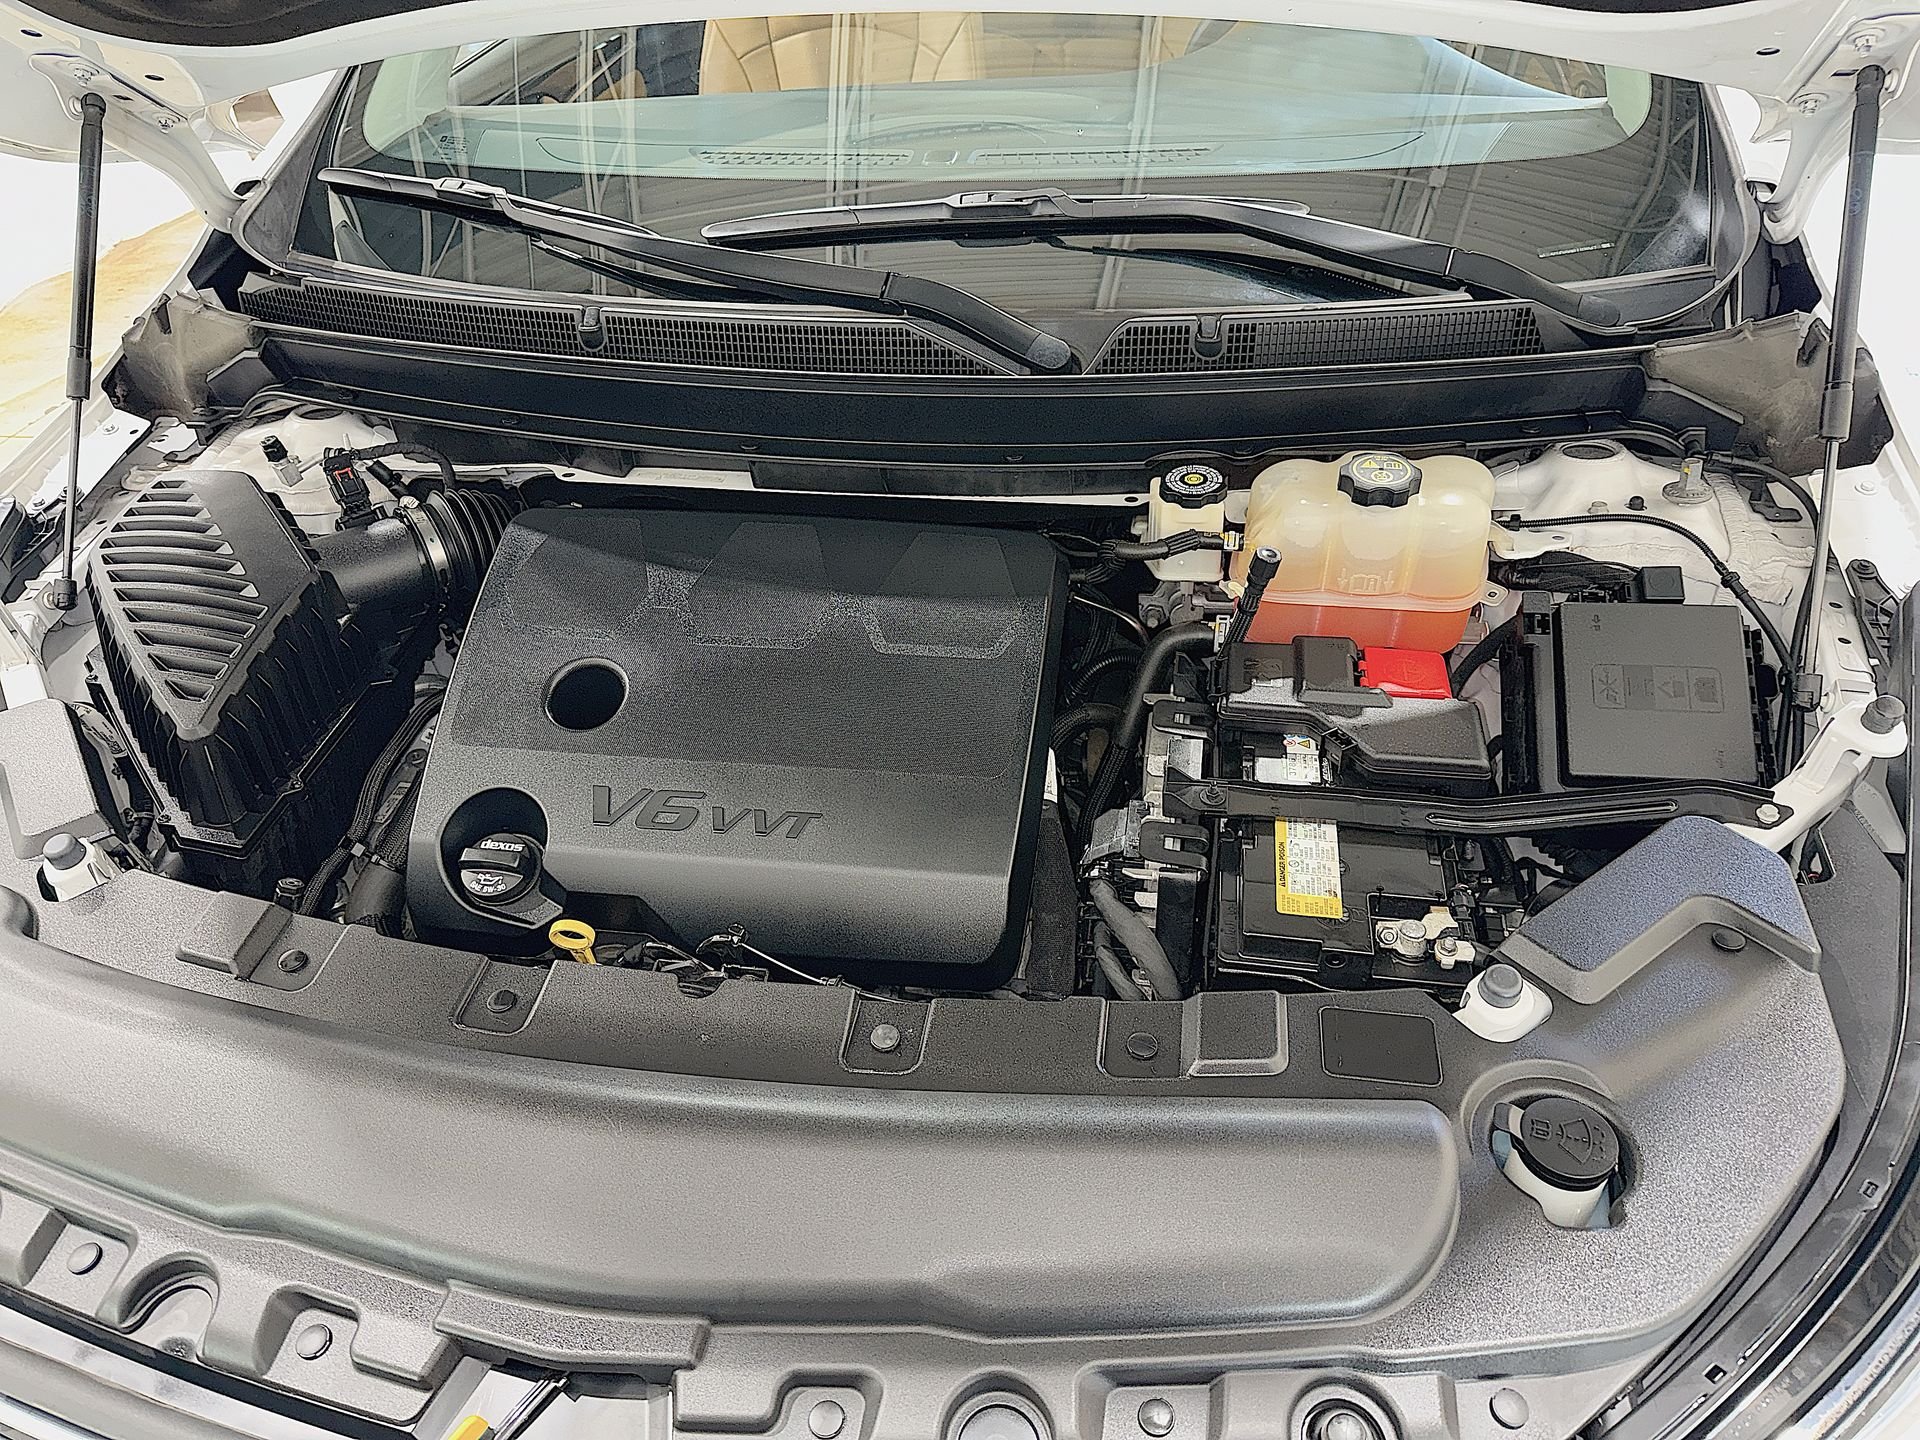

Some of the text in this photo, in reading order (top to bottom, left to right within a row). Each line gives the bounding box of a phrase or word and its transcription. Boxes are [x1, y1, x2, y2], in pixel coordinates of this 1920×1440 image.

[592, 785, 823, 839] V6 VVT
[480, 839, 526, 852] dexos
[1278, 841, 1287, 882] DANGER POISON
[469, 880, 482, 891] SAE
